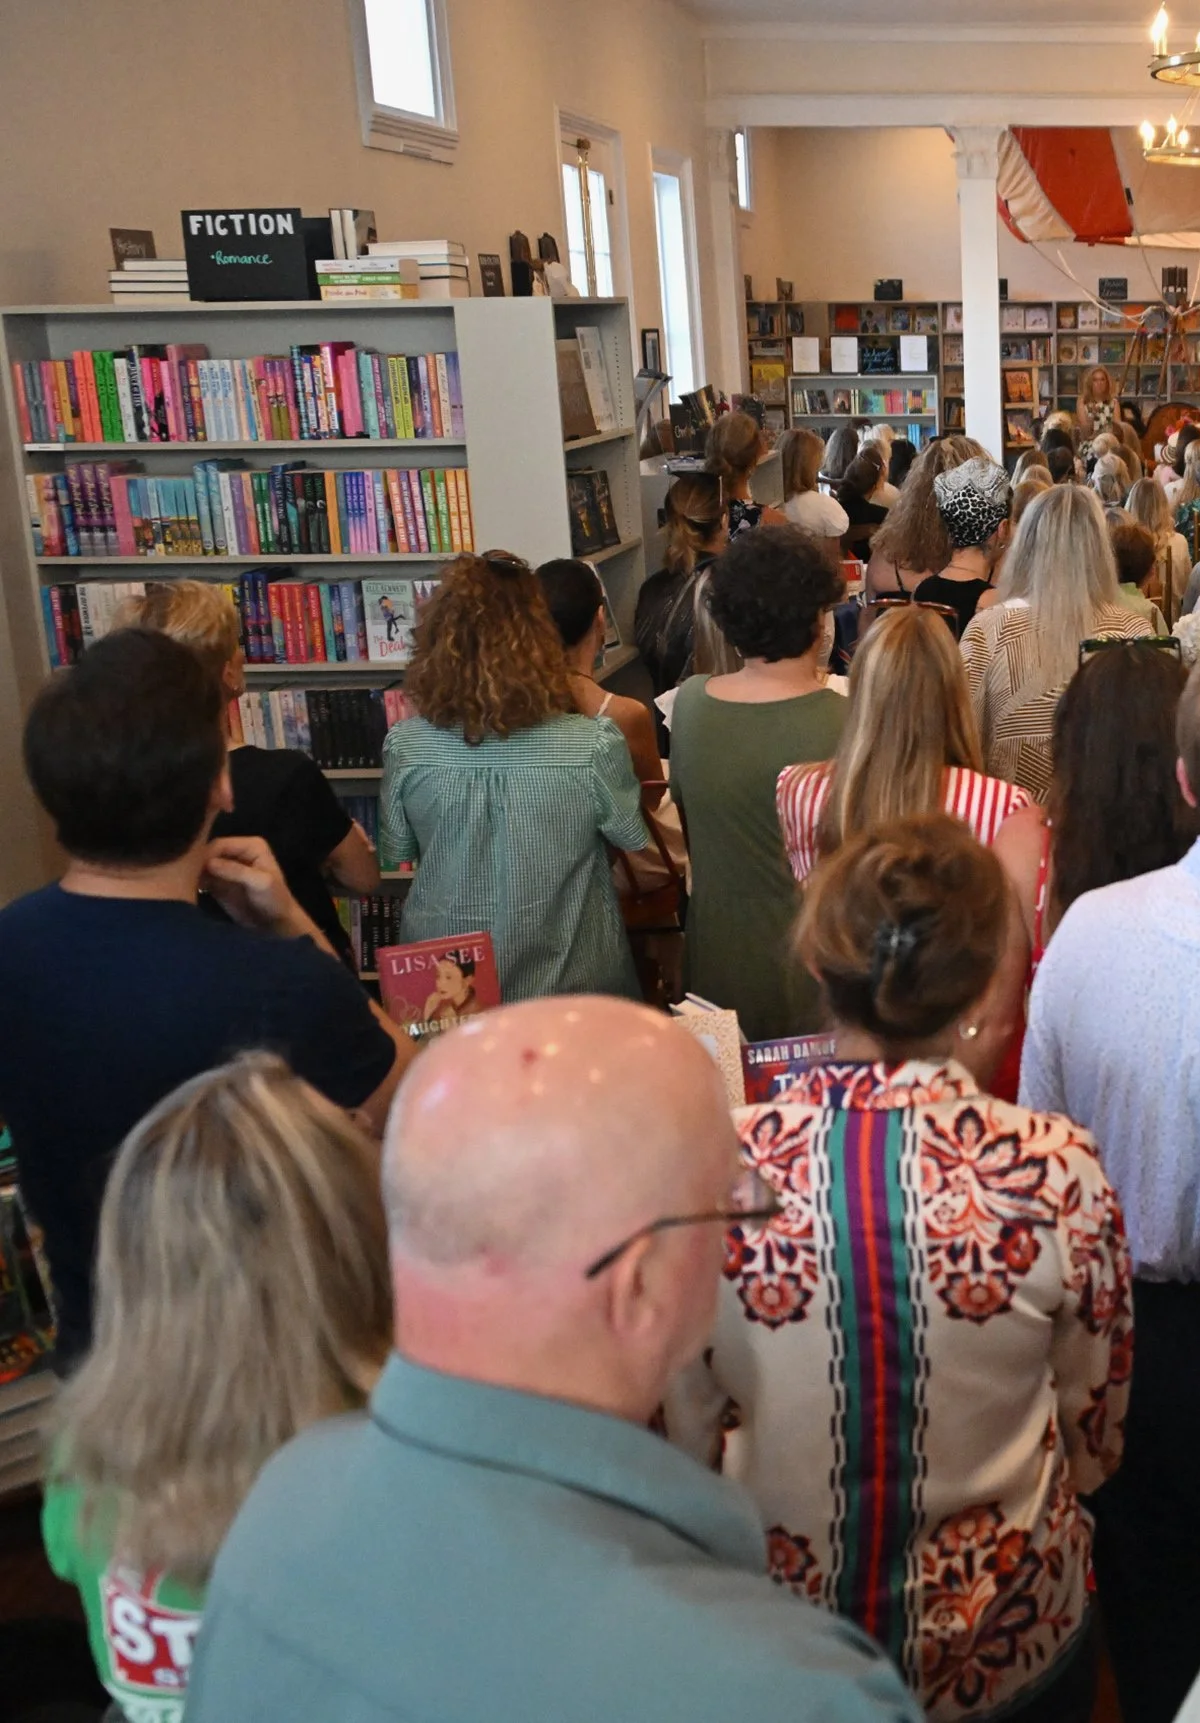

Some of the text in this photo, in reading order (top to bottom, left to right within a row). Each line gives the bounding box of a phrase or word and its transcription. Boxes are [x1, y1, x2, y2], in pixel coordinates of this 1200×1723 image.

[189, 213, 294, 235] FICTION
[215, 250, 272, 265] Romance
[366, 584, 408, 593] ELLE KENNEDY
[379, 636, 406, 657] Deal
[391, 946, 485, 975] LISA SEE
[402, 1015, 470, 1037] AUGHTE
[747, 1045, 790, 1064] SARAH
